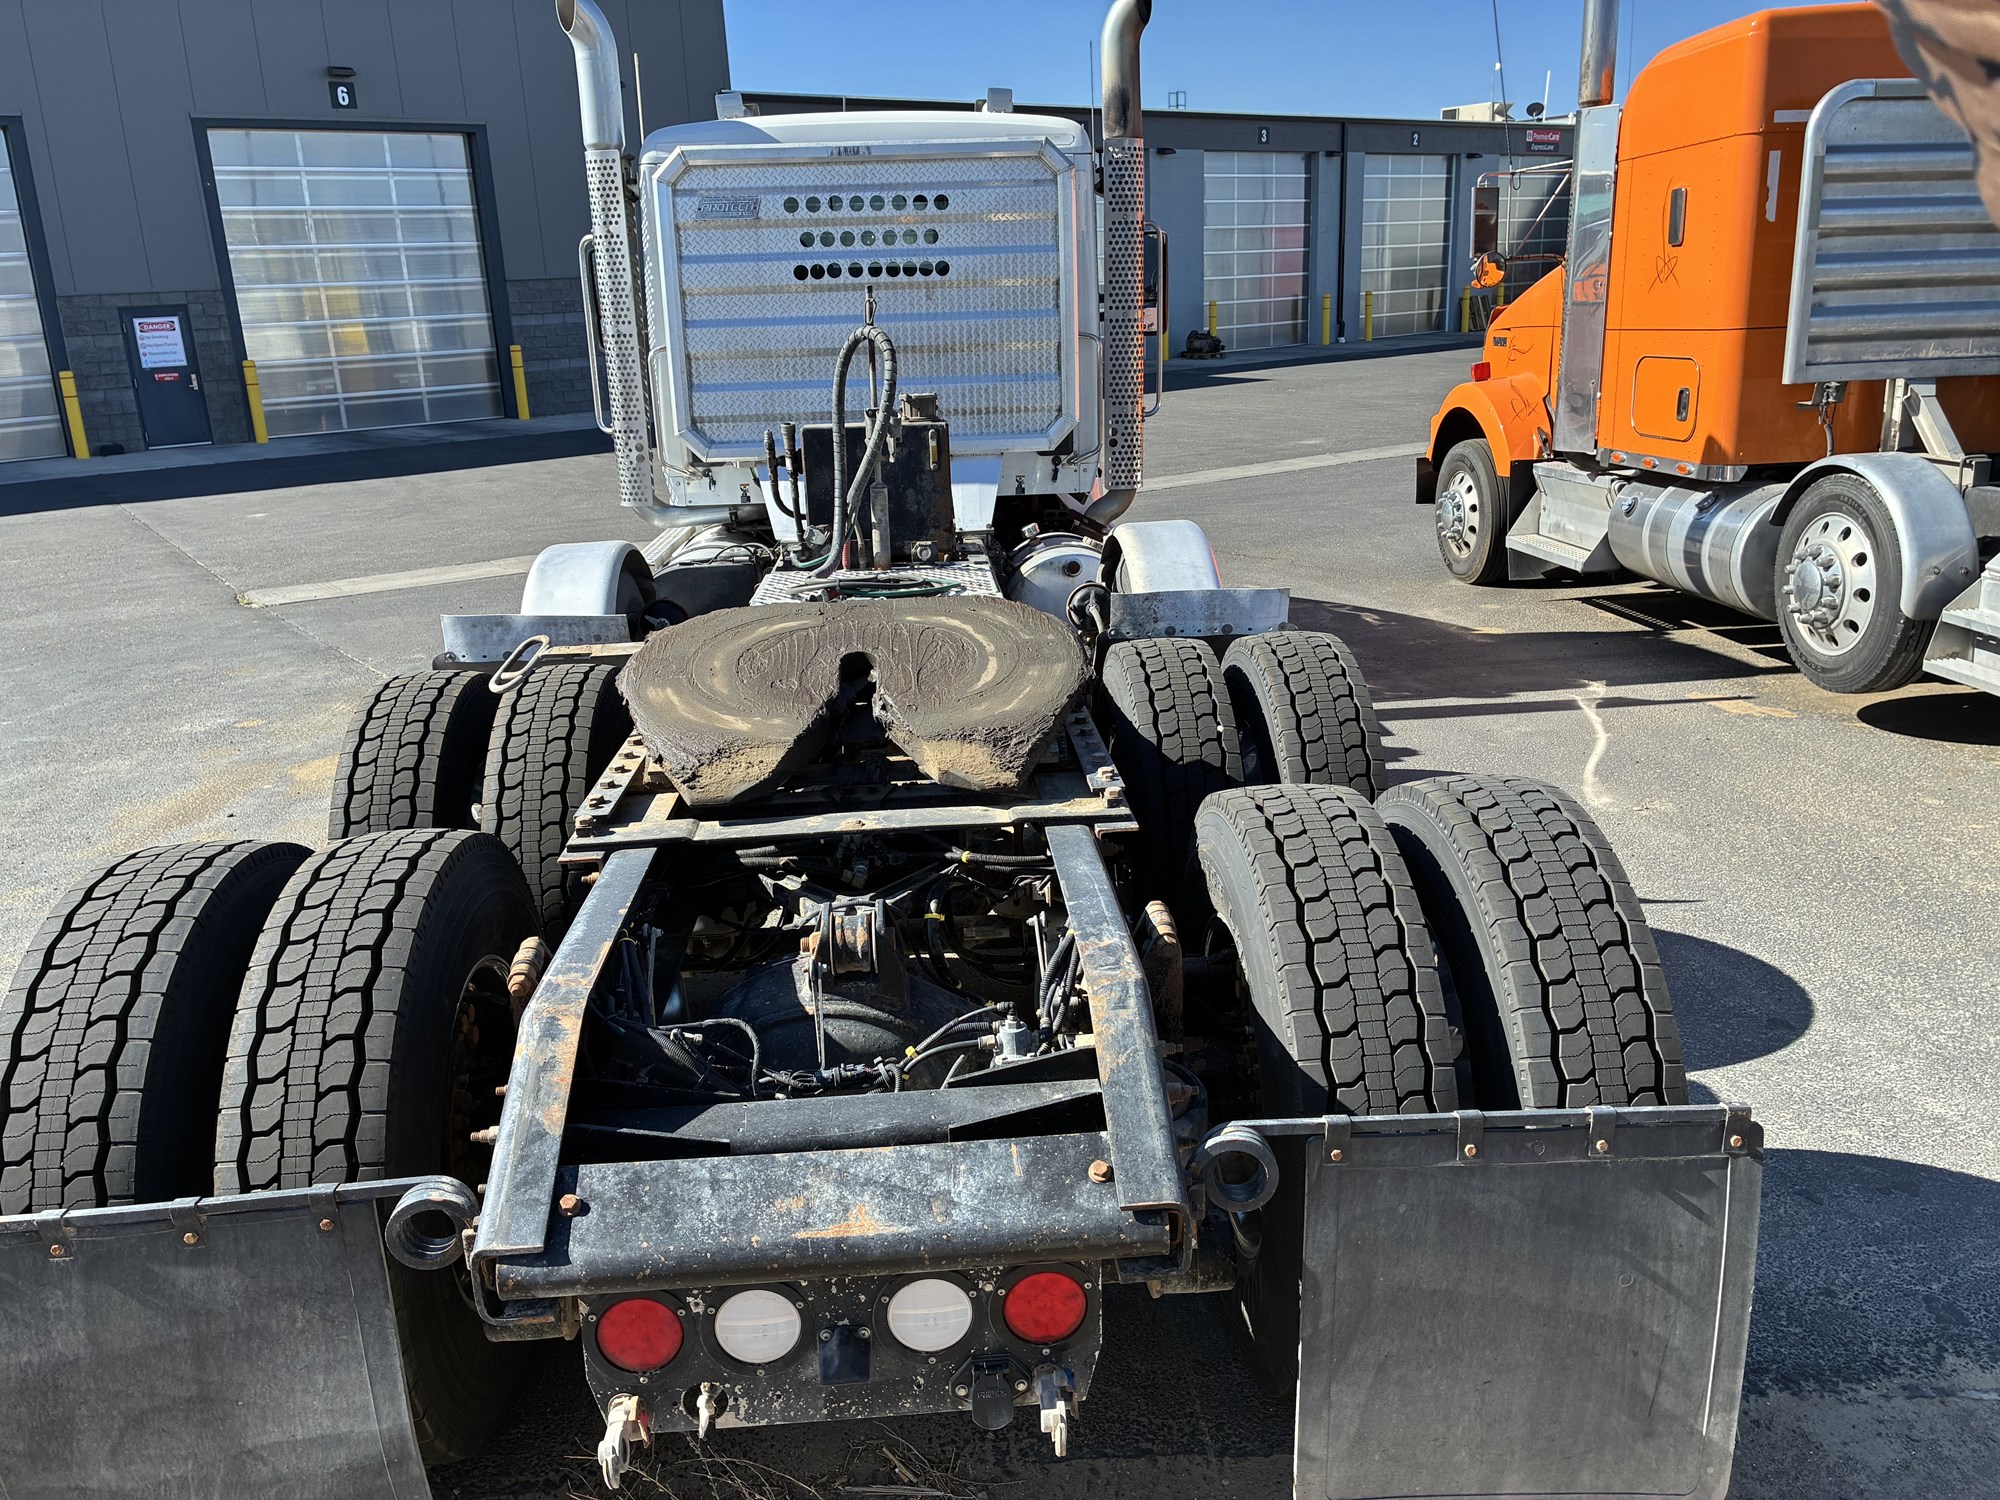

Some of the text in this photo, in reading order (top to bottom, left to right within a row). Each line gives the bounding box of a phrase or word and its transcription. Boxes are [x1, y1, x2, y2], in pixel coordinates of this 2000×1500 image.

[337, 86, 349, 106] 6
[1261, 129, 1267, 142] 3
[1413, 133, 1419, 146] 2
